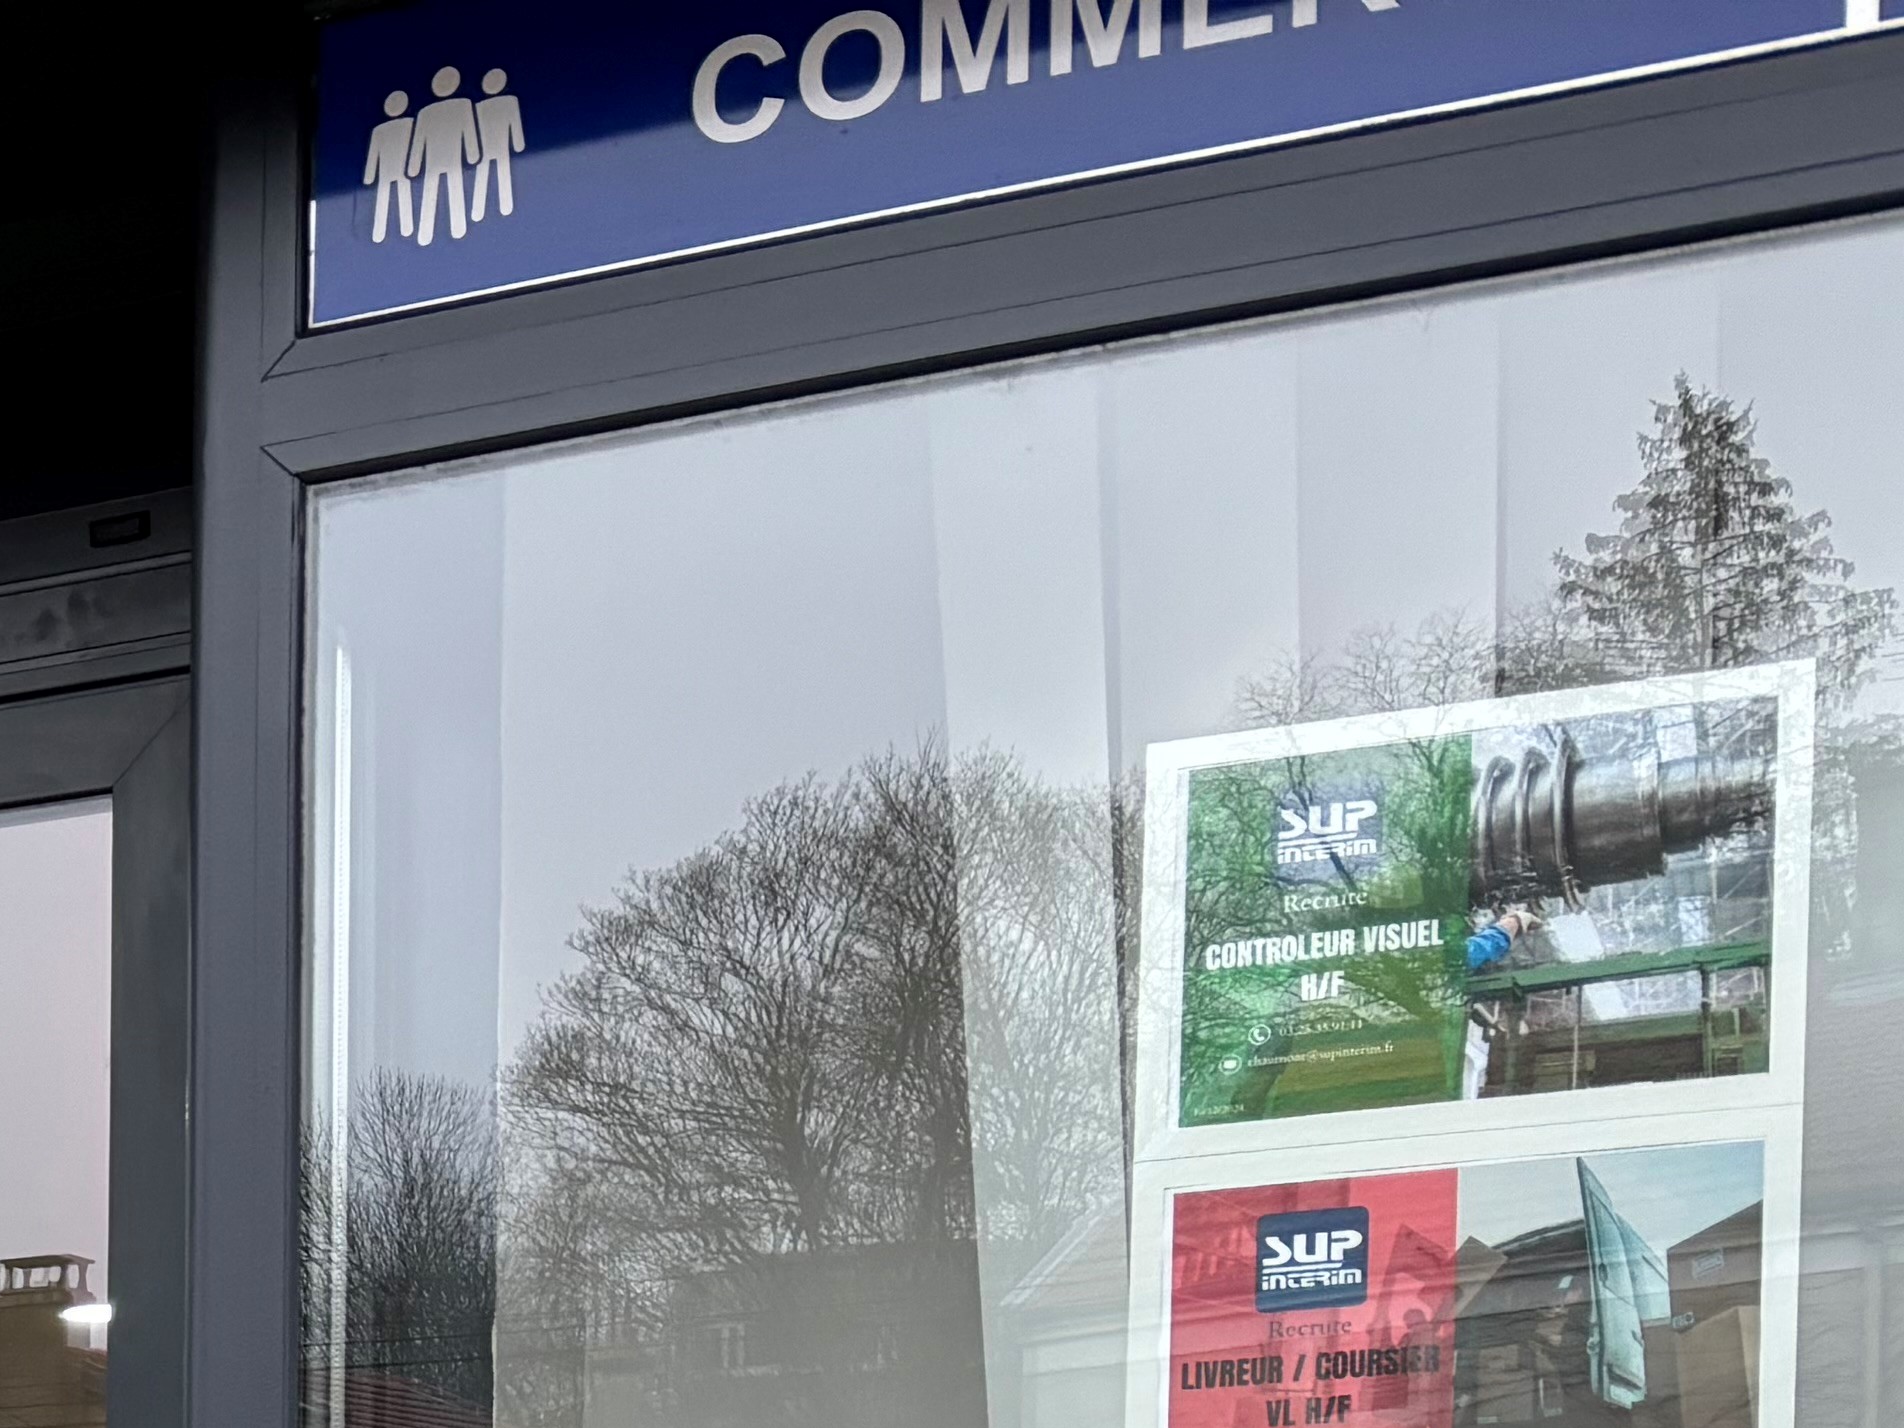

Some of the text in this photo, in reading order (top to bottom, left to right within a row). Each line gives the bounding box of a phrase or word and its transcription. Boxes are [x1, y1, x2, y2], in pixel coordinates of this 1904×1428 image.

[690, 0, 1397, 144] COMM
[1277, 800, 1378, 840] SUP
[1205, 918, 1444, 971] CONTROLEUR VISUEL
[1300, 970, 1345, 1001] H/F
[1261, 1229, 1363, 1266] SUP
[1269, 1319, 1352, 1339] Recrute
[1181, 1344, 1440, 1390] LIVREUR / COURSIER
[1266, 1394, 1352, 1428] VL H/F
